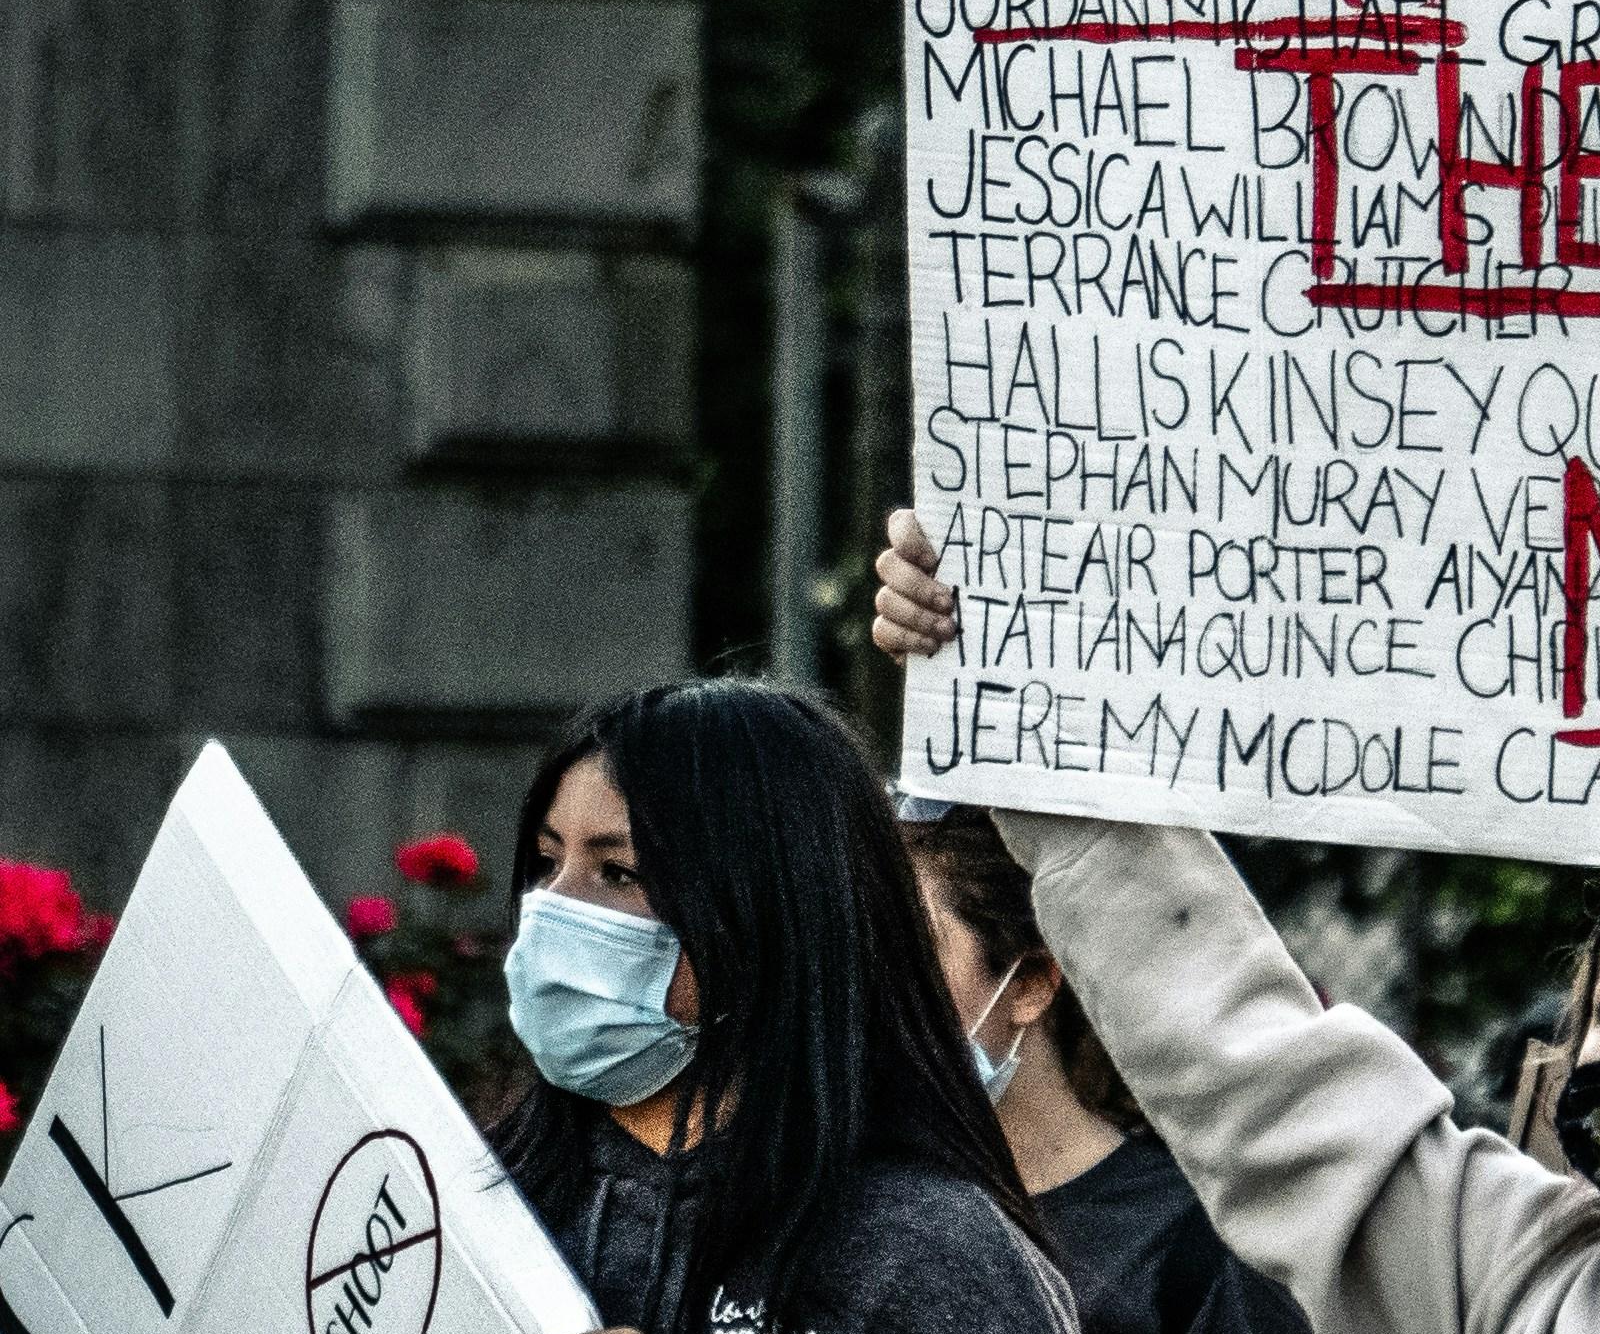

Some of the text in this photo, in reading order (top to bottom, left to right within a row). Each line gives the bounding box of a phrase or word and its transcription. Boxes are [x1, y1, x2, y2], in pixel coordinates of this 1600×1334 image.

[923, 41, 1226, 154] MICHAEL
[1253, 68, 1518, 178] BROWN
[926, 129, 1172, 239] JESSICA
[1180, 166, 1495, 250] WILLIAMS
[928, 230, 1250, 333] TERRANCE
[1261, 247, 1568, 342] CRUTCHER
[1209, 345, 1505, 456] KINSEY
[927, 405, 1199, 516] STEPHAN
[1218, 455, 1445, 546] MURAY
[1189, 528, 1394, 610] PORTER
[1196, 610, 1436, 683] QUINCE
[926, 677, 1201, 791] JEREMY
[1217, 706, 1465, 798] MCDOLE
